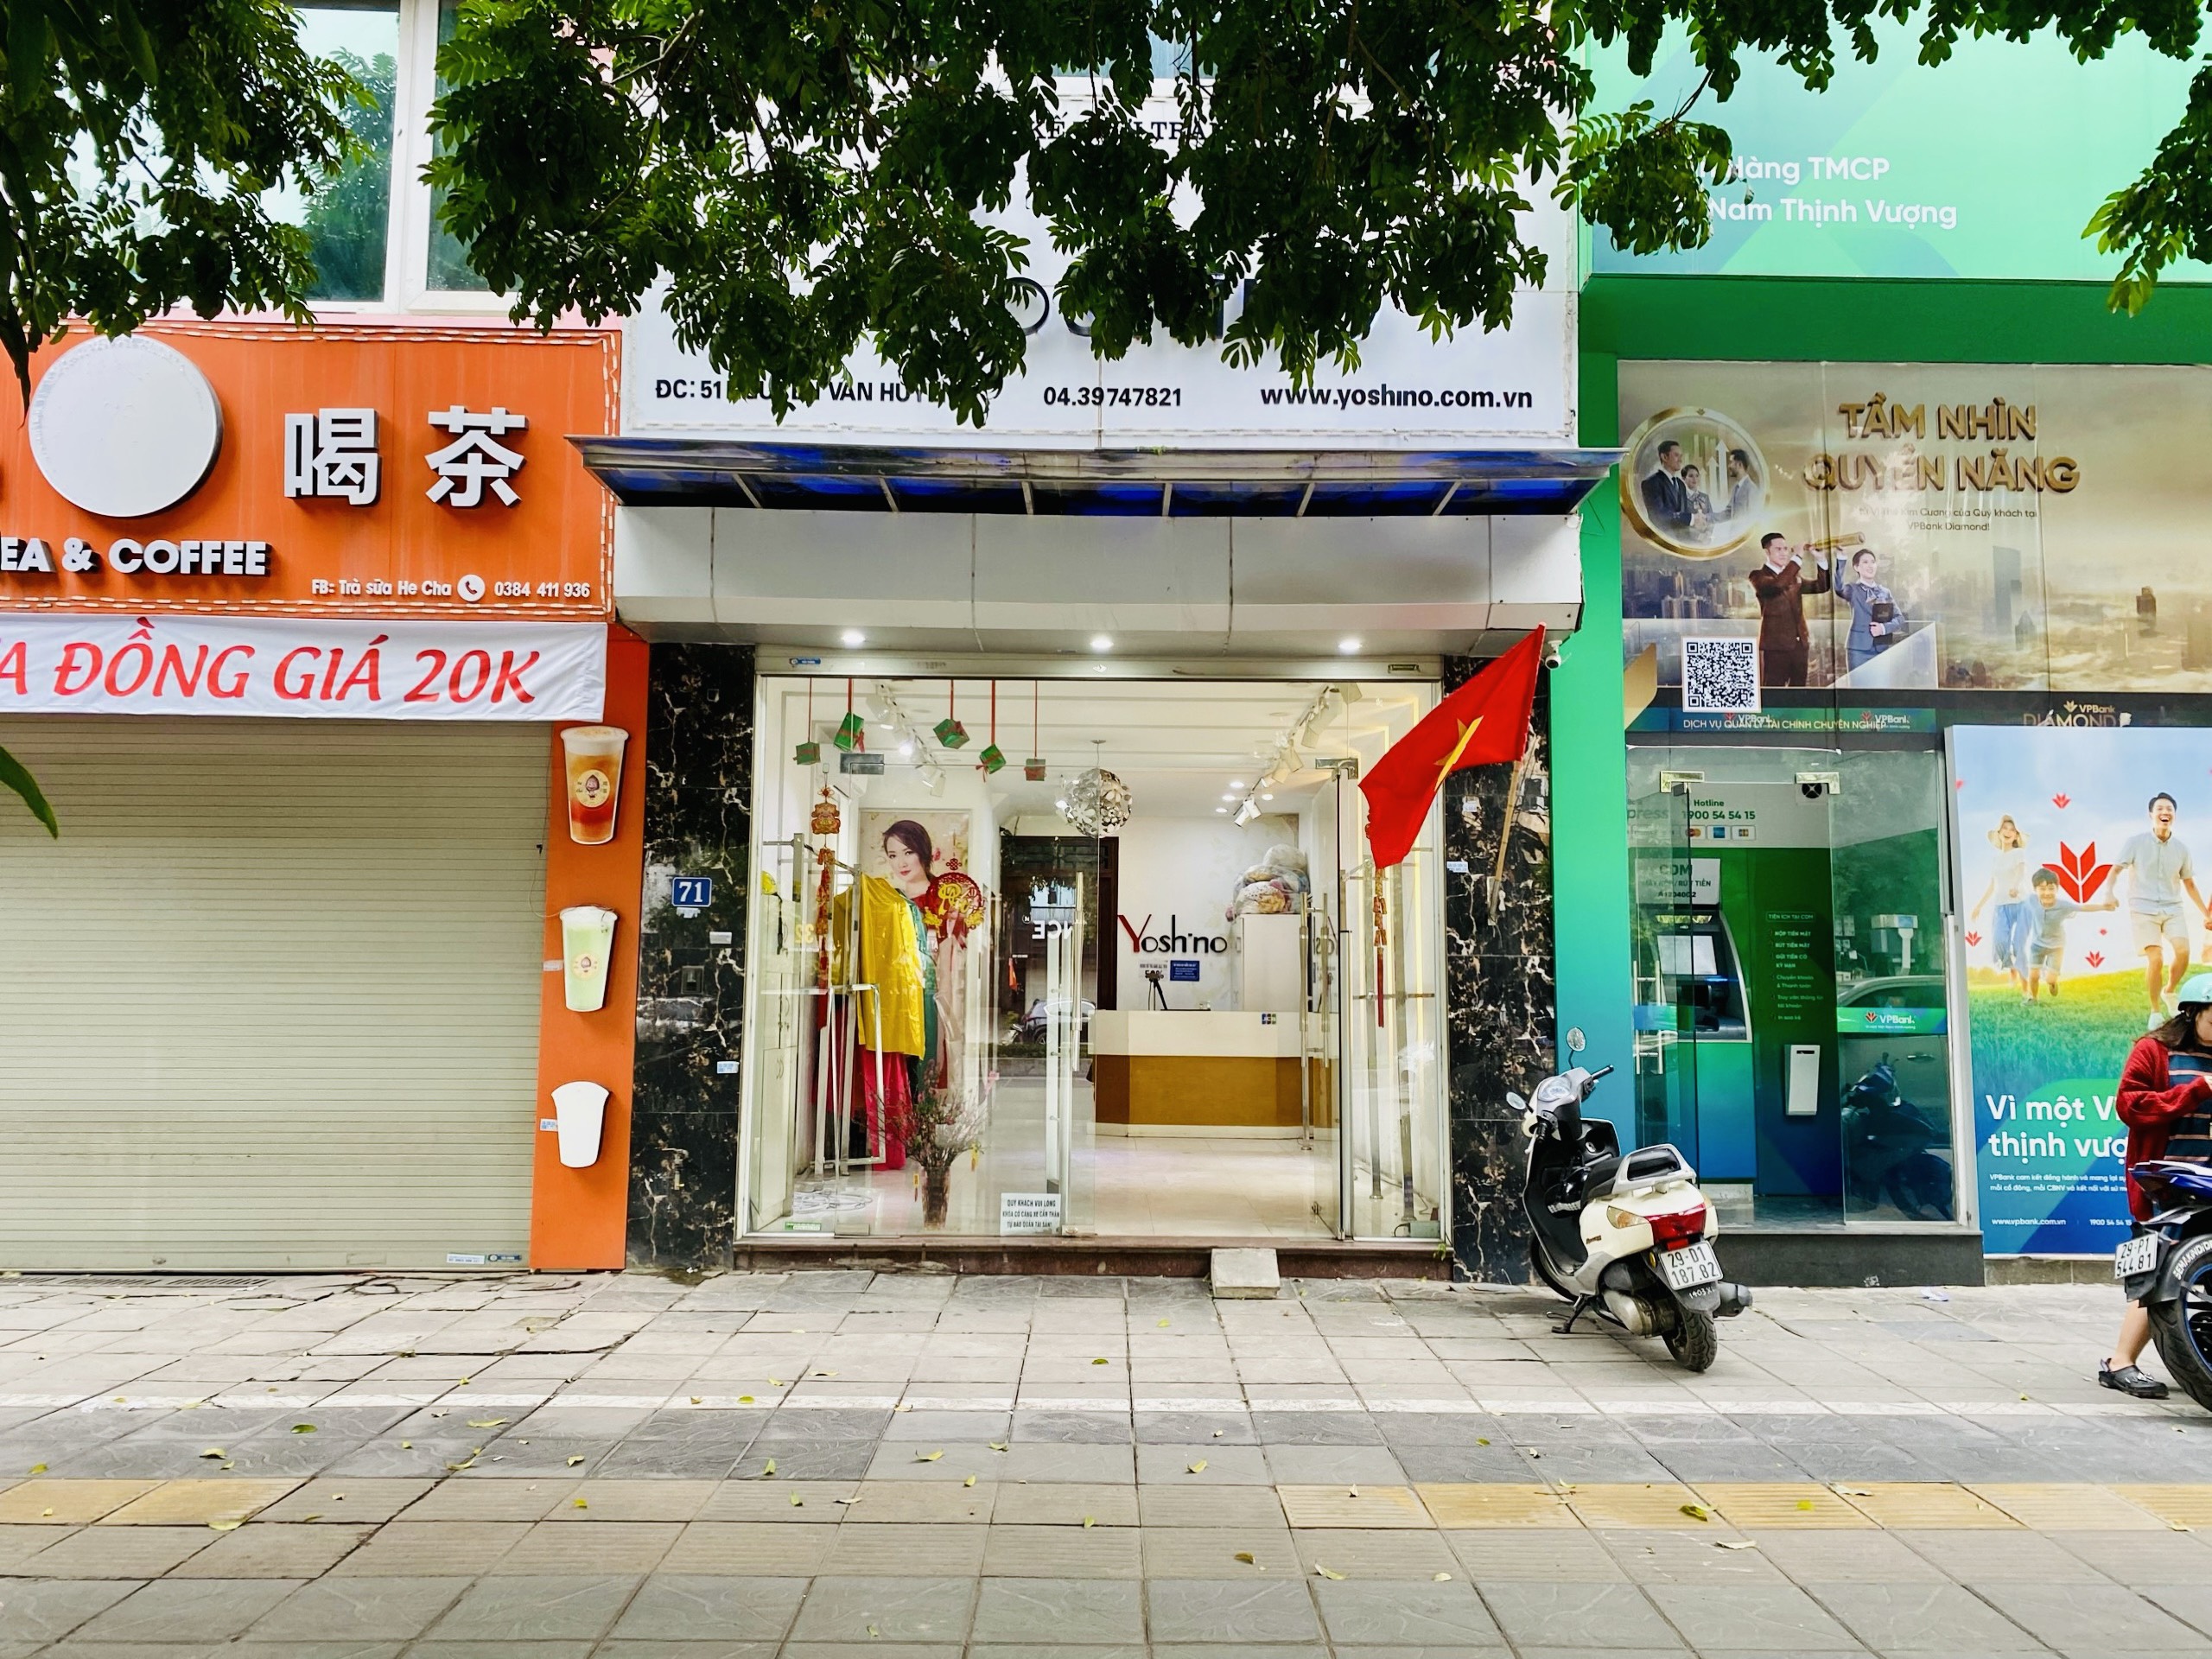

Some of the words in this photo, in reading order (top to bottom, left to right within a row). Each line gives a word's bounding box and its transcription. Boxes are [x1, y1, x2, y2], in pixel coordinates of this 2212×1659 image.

[1808, 156, 1891, 181] TMCP
[1708, 198, 1772, 221] Nam
[1780, 198, 1857, 228] Thịnh
[1866, 199, 1957, 230] Vượng
[655, 379, 696, 399] ĐC:
[701, 380, 721, 399] 51
[1043, 387, 1181, 407] 04.39747821
[1260, 383, 1533, 410] www.yoshino.com.vn
[1838, 391, 1926, 440] TẦM
[1936, 397, 2037, 440] NHÌN
[284, 405, 525, 507] 喝茶
[1957, 448, 2081, 493] NĂNG
[1994, 508, 2023, 518] khách
[1908, 522, 1942, 531] VPBank
[61, 537, 92, 572] &
[108, 537, 266, 575] COFFEE
[312, 579, 334, 594] FB:
[339, 577, 361, 594] Trà
[397, 580, 416, 595] He
[422, 580, 452, 596] Cha
[494, 582, 531, 597] 0384
[537, 582, 559, 597] 411
[564, 582, 590, 598] 936
[54, 616, 256, 699] ĐỒNG
[273, 634, 389, 702] GIÁ
[403, 648, 540, 705] 20K
[2079, 703, 2115, 713] VPBank
[1683, 719, 1707, 730] DỊCH
[1708, 719, 1722, 731] VỤ
[1782, 719, 1812, 729] CHÍNH
[1713, 810, 1726, 820] 54
[1729, 810, 1741, 820] 54
[1745, 810, 1756, 820] 15
[678, 881, 703, 903] 71
[1117, 914, 1228, 953] Yoshno
[1985, 1094, 2017, 1121] Vì
[2025, 1095, 2086, 1128] một
[1988, 1131, 2066, 1165] thịnh
[2074, 1135, 2129, 1165] vượ
[1667, 1246, 1707, 1268] 29-D1
[2120, 1236, 2150, 1260] 29-P1
[1671, 1262, 1719, 1286] 187.82
[2116, 1253, 2152, 1277] 544.81
